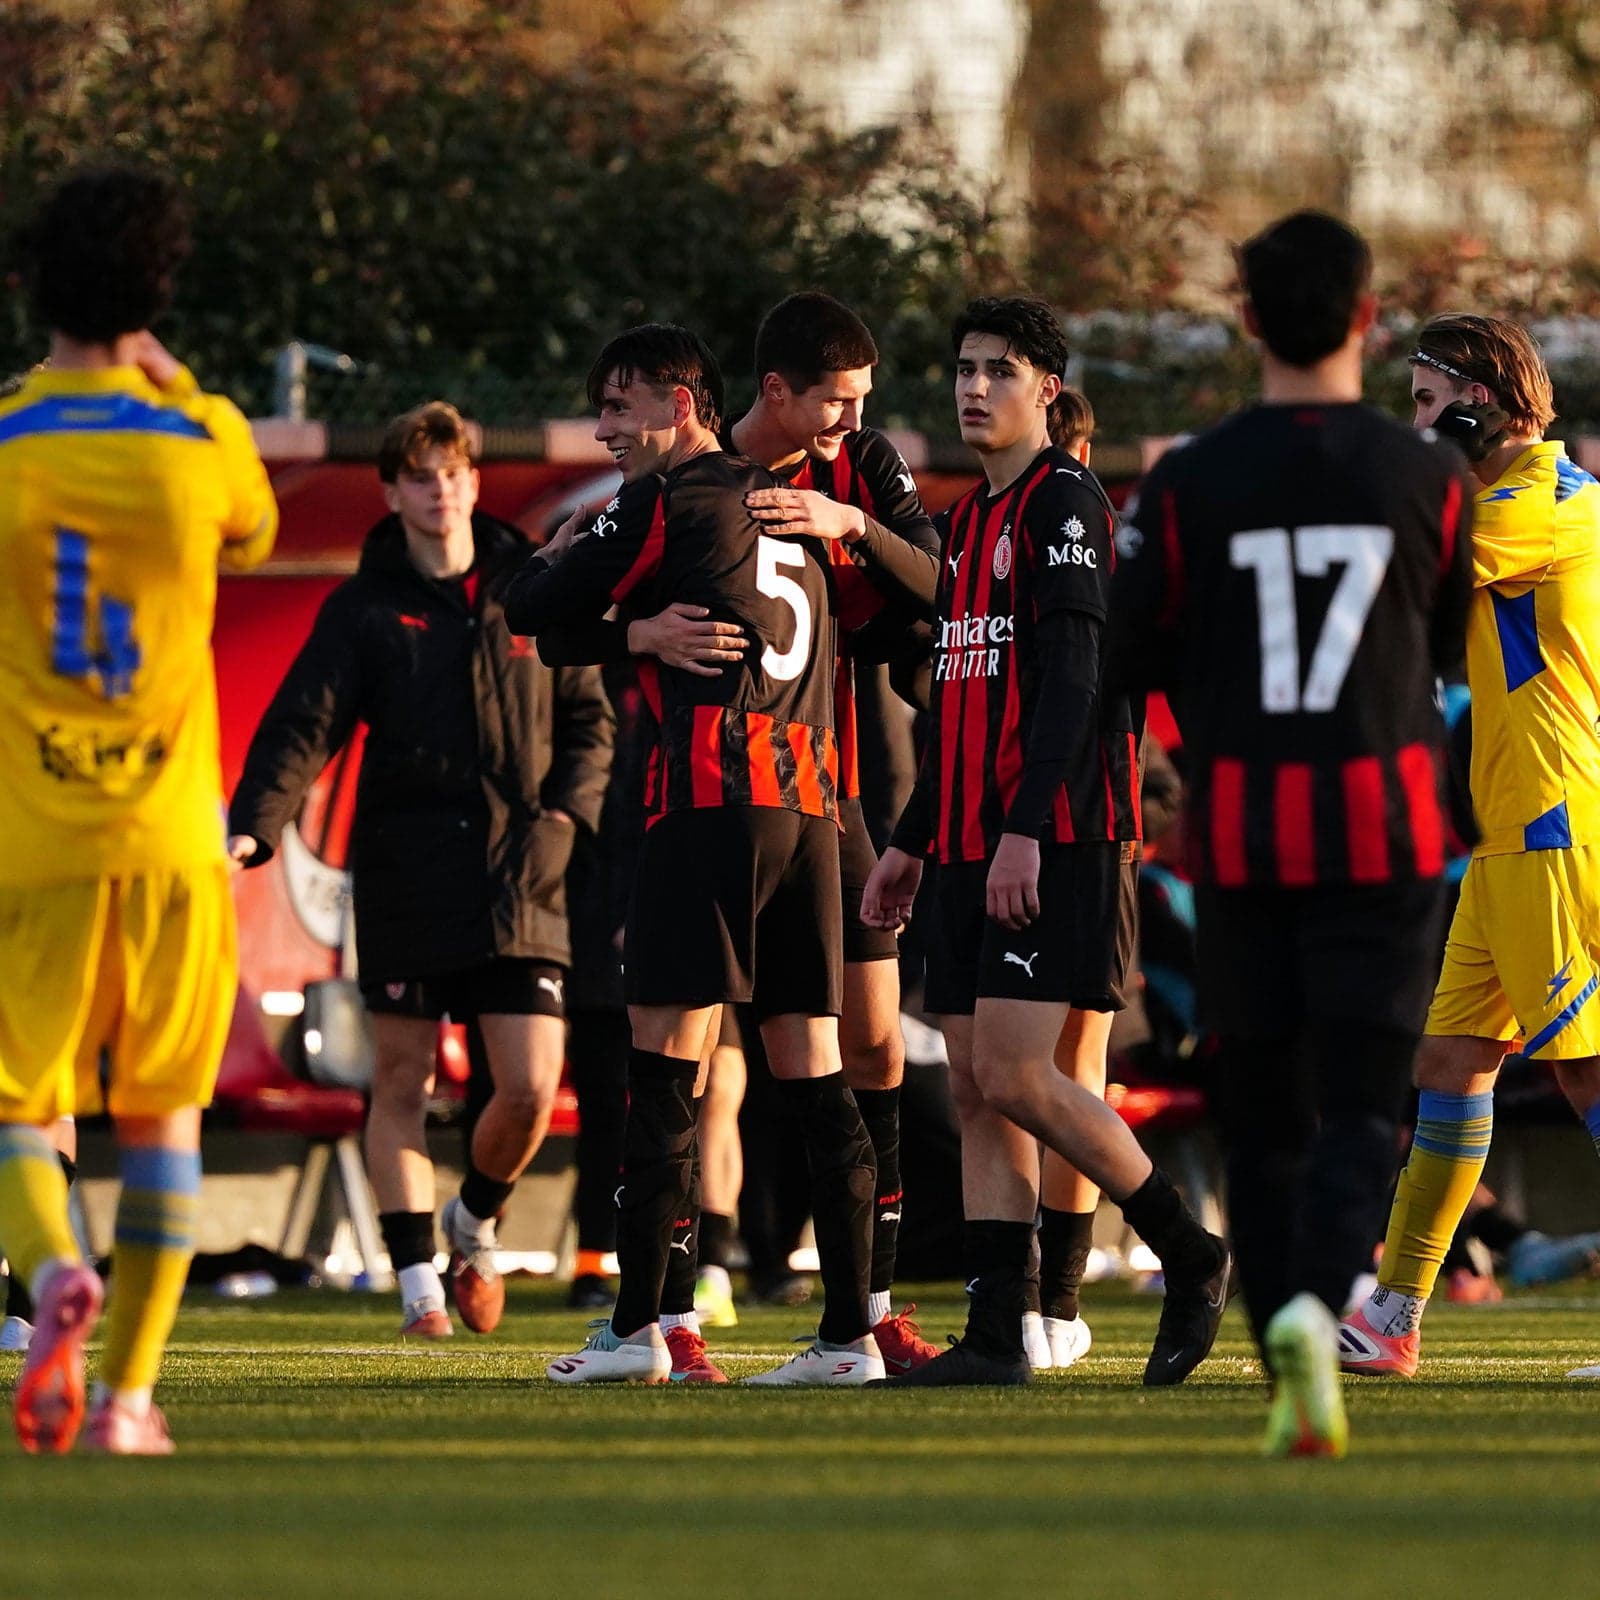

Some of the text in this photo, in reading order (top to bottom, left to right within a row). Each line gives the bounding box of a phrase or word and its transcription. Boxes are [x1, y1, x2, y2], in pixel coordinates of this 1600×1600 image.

[591, 514, 617, 537] SC
[1048, 543, 1097, 568] MSC
[54, 529, 139, 697] 4
[756, 535, 811, 681] 5
[1230, 525, 1394, 713] 17
